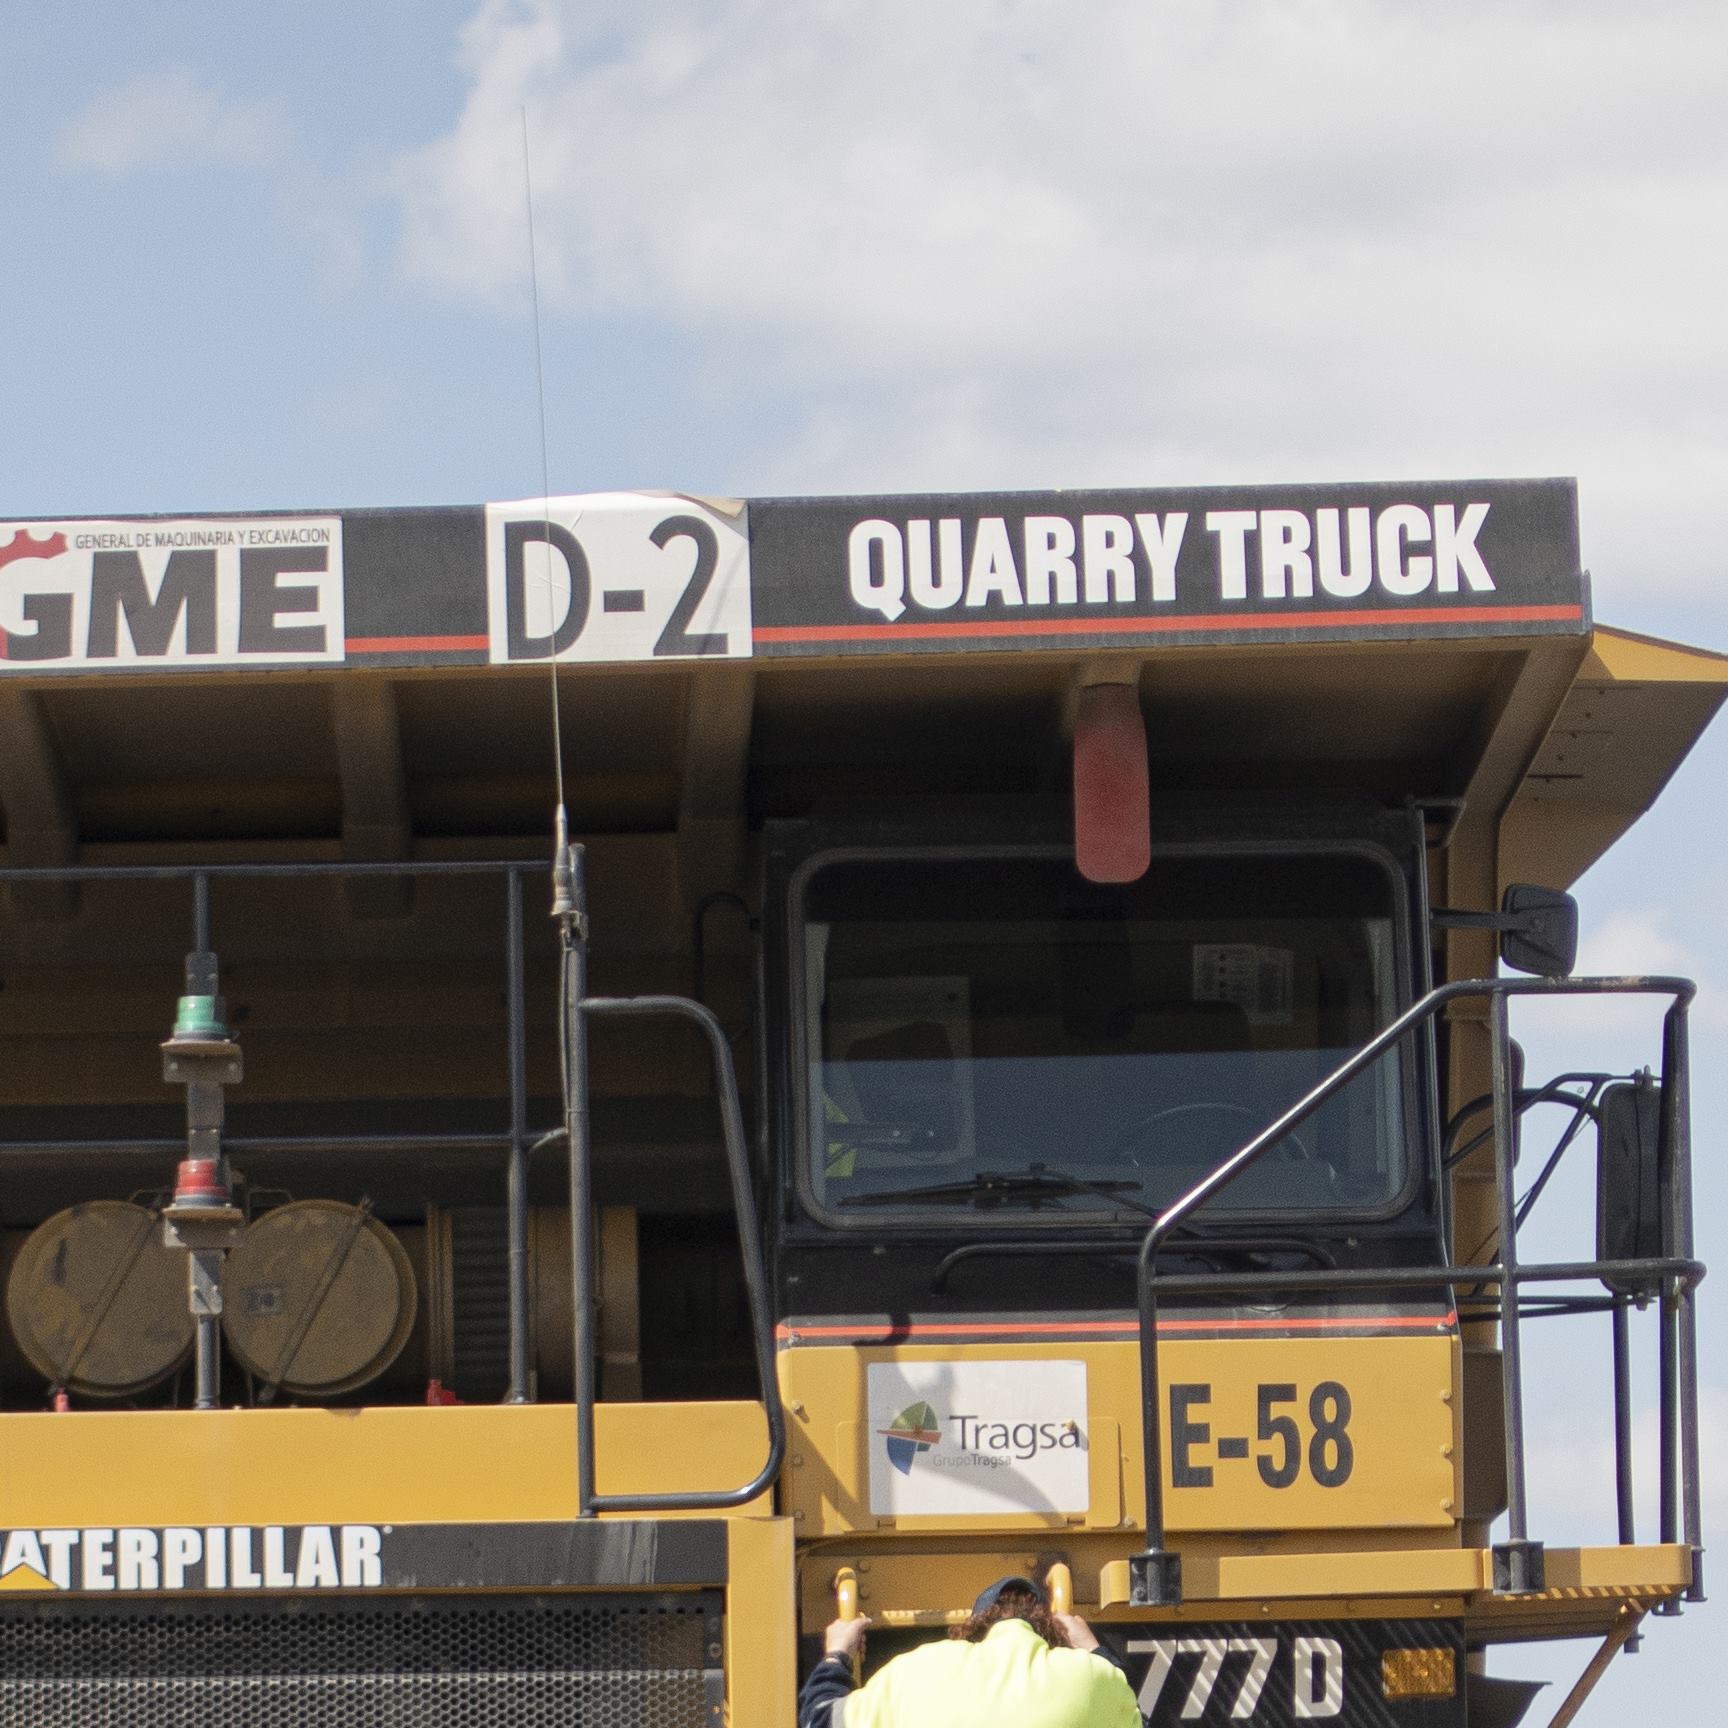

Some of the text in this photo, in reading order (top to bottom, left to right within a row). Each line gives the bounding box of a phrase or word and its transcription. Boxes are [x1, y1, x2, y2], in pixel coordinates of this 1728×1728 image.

[75, 528, 330, 549] GENERAL DE MAQUINARIA Y EXCAVACION
[504, 514, 730, 660] D-2
[847, 502, 1496, 621] QUARRY TRUCK
[949, 1415, 1081, 1460] Tragsa
[1169, 1381, 1353, 1488] E-58
